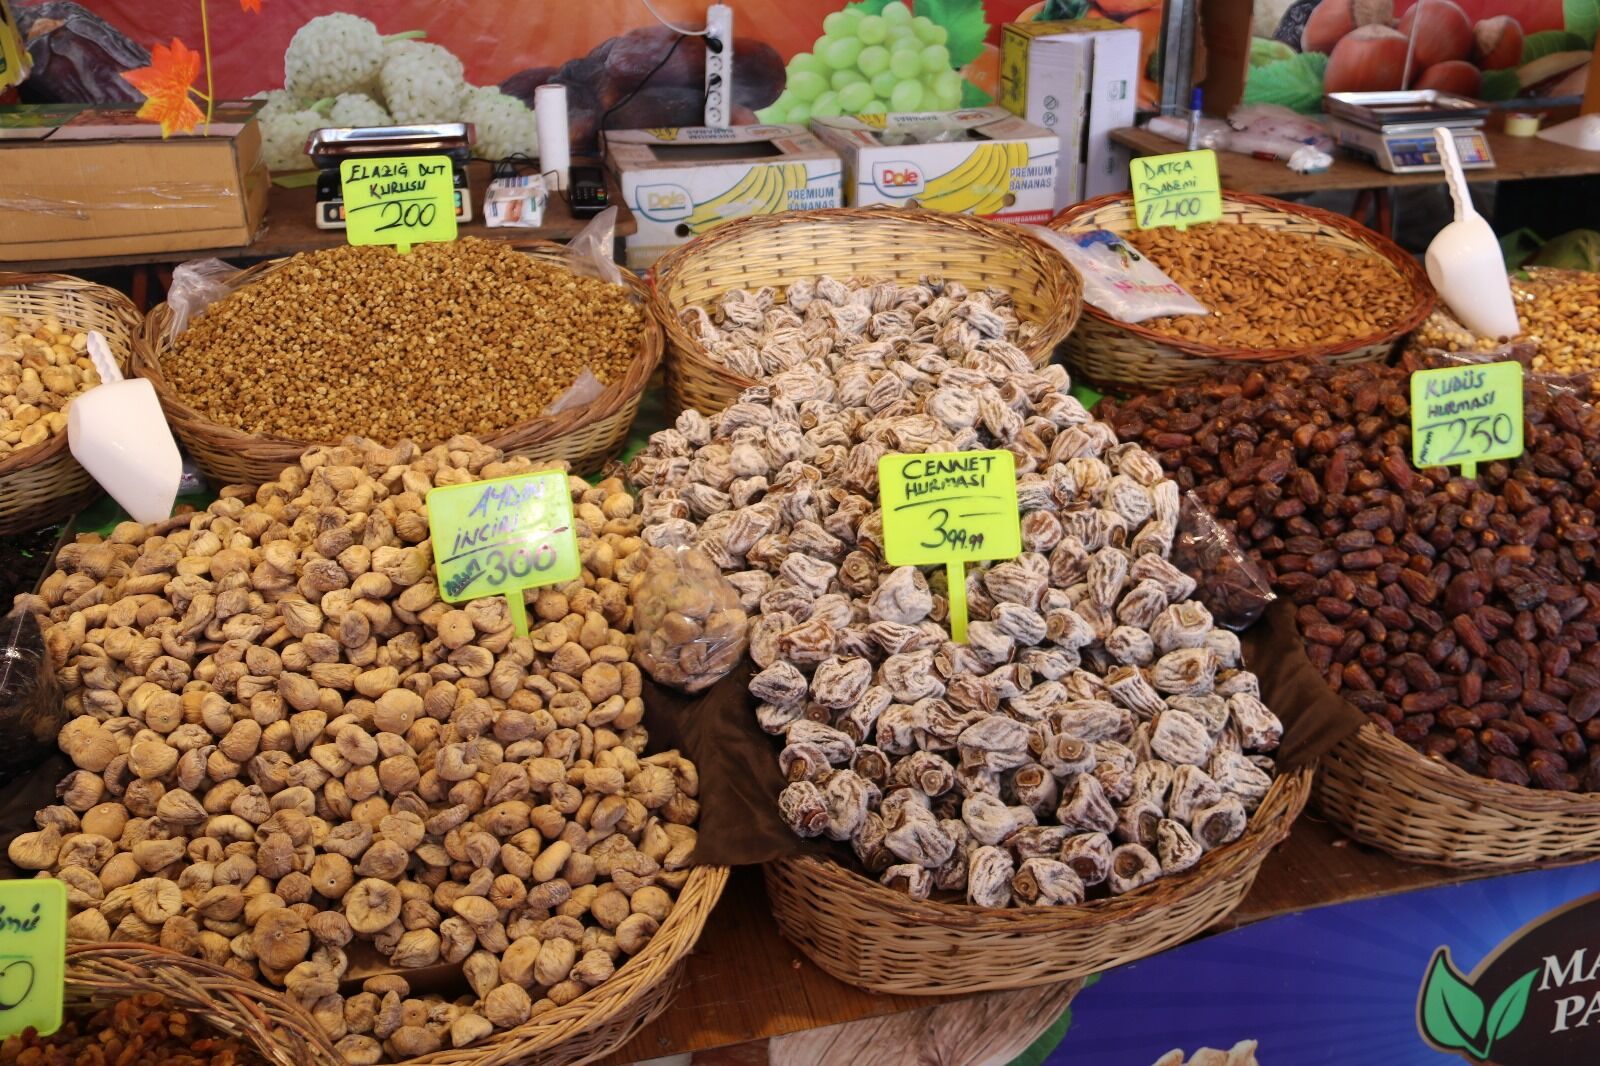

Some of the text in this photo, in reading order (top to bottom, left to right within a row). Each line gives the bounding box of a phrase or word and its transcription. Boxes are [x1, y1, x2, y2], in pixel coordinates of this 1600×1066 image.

[418, 163, 446, 176] DUT
[882, 168, 918, 186] Dole
[1010, 166, 1052, 178] PREMIUM
[1142, 160, 1193, 180] DATÇA
[1009, 178, 1052, 190] BANANAS
[647, 191, 687, 208] Dole
[787, 187, 834, 200] PREMIUM
[374, 201, 436, 232] 200
[1439, 413, 1513, 462] 250
[902, 456, 996, 479] CENNET
[486, 543, 557, 586] 300
